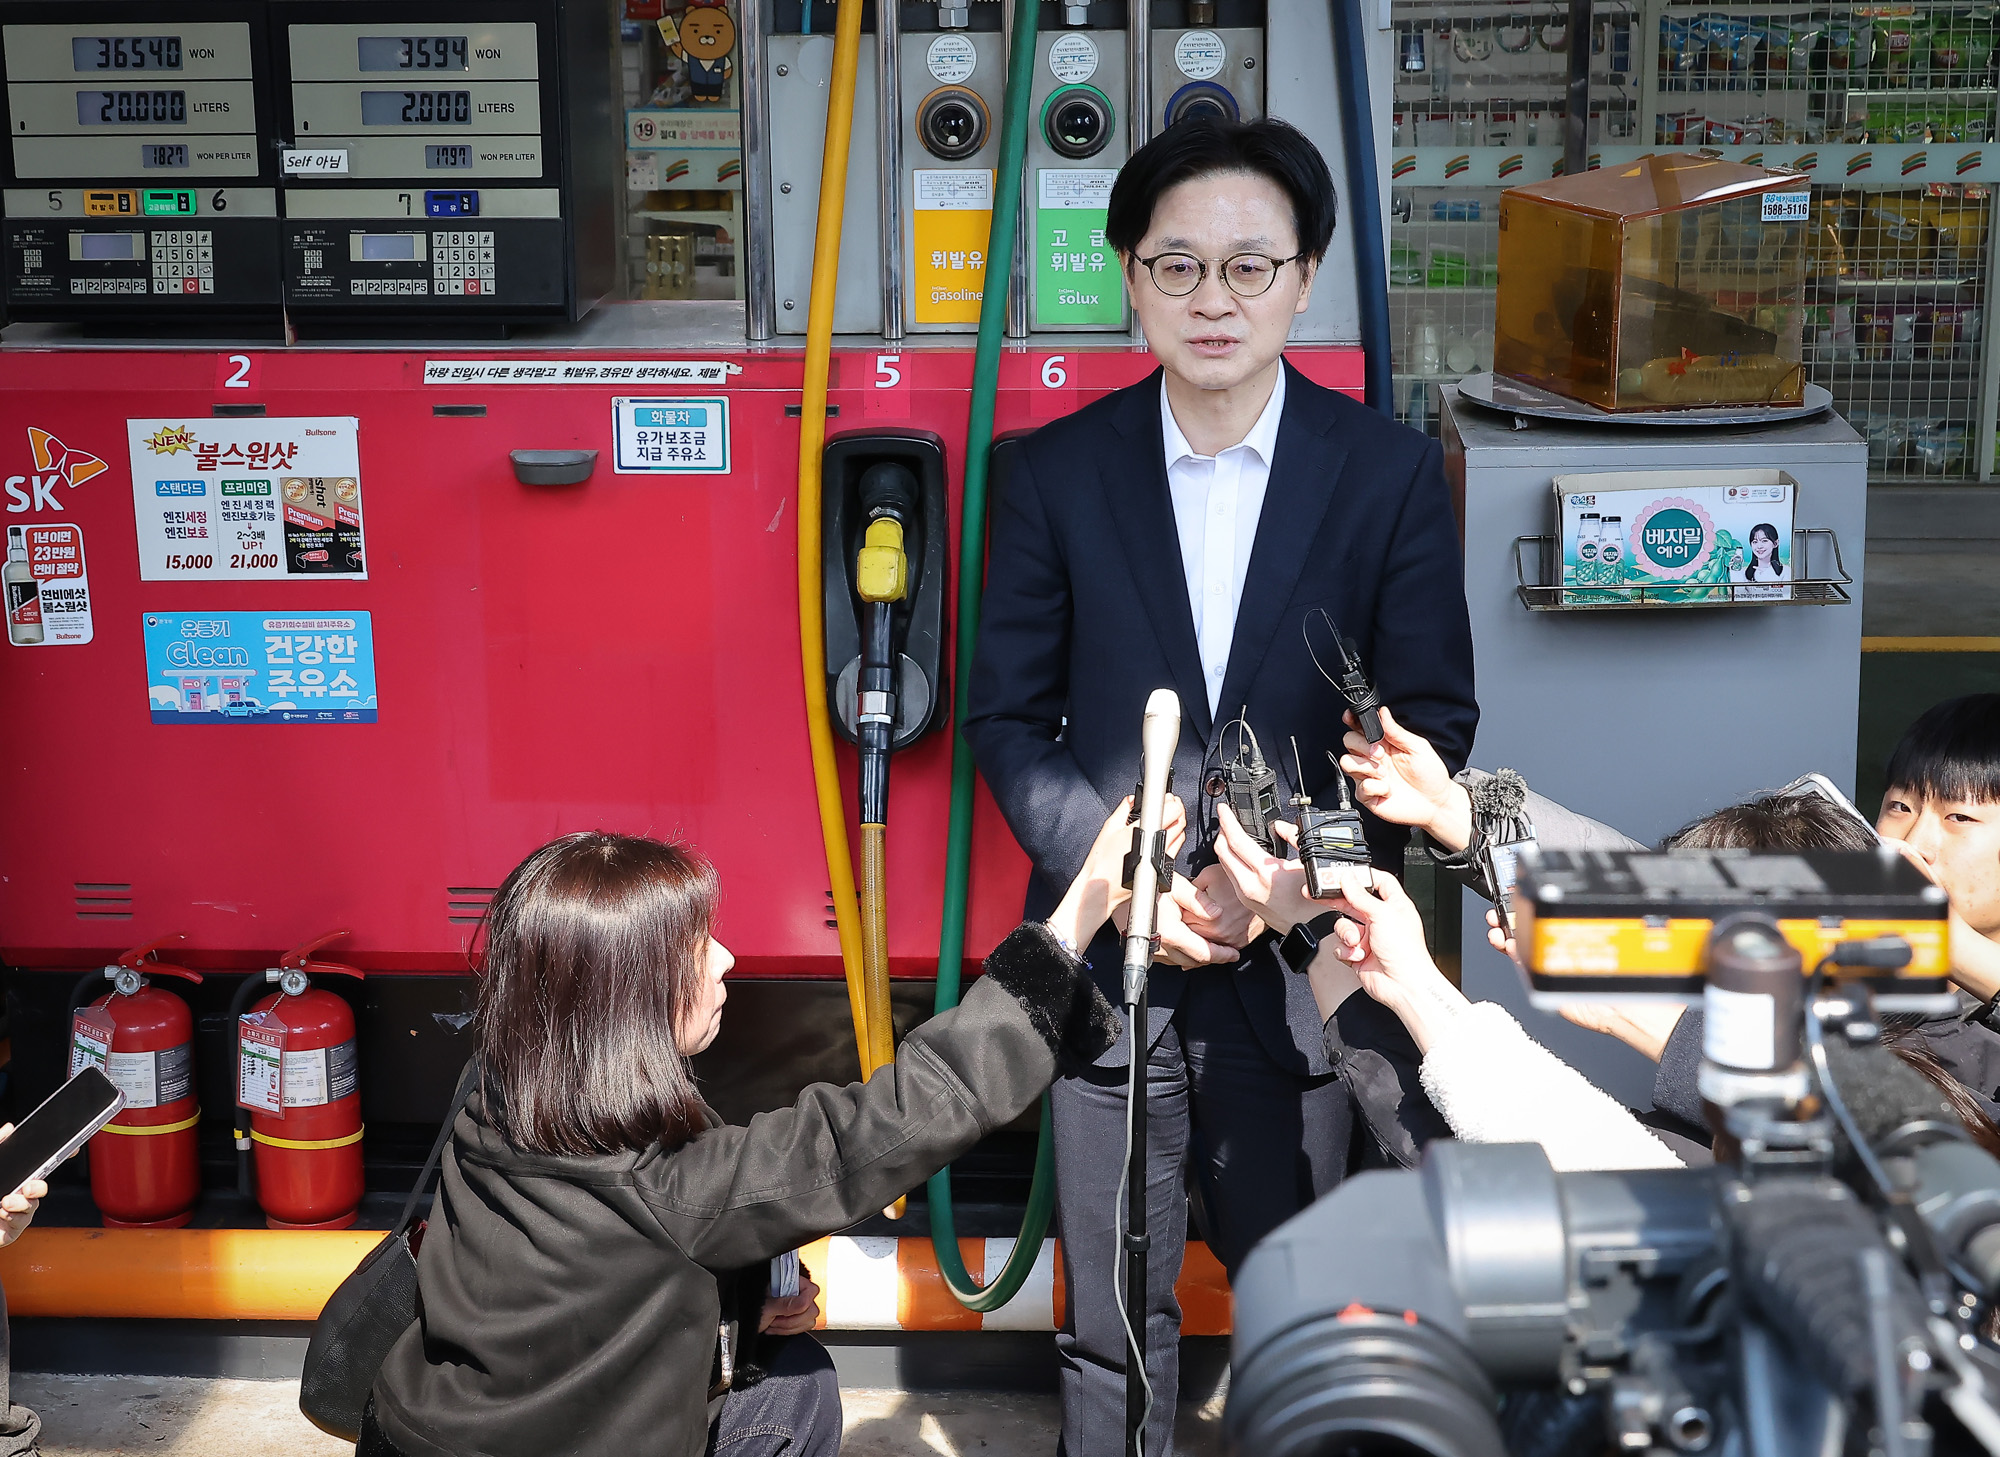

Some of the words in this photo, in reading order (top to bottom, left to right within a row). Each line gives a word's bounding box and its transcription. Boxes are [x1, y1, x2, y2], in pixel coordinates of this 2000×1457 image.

[97, 38, 181, 68] 36540
[189, 49, 215, 59] WON
[400, 38, 466, 68] 3594
[475, 49, 501, 59] WON
[101, 92, 185, 122] 20.000
[193, 102, 230, 113] LITERS
[402, 92, 469, 122] 2.000
[478, 103, 515, 113] LITERS
[637, 123, 653, 137] 19
[153, 147, 184, 165] 1827
[196, 152, 214, 160] WON
[215, 152, 229, 160] PER
[231, 152, 251, 160] LITER
[286, 155, 311, 168] Self
[315, 154, 342, 169] 아님
[436, 147, 466, 166] 1797
[480, 153, 498, 161] WON
[499, 153, 513, 161] PER
[515, 153, 535, 161] LITER
[48, 191, 63, 211] 5
[212, 189, 227, 211] 6
[398, 193, 412, 215] 7
[1763, 204, 1807, 215] 1588-5116
[155, 234, 163, 243] 7
[170, 234, 178, 243] 8
[186, 234, 193, 243] 9
[436, 234, 444, 244] 7
[452, 234, 459, 244] 8
[467, 234, 475, 244] 9
[155, 250, 163, 259] 4
[171, 250, 178, 259] 5
[186, 250, 194, 259] 6
[436, 251, 444, 260] 4
[452, 251, 459, 260] 5
[468, 251, 475, 260] 6
[930, 251, 985, 270] 휘발유
[1050, 252, 1107, 272] 휘발유
[157, 266, 162, 275] 1
[172, 266, 179, 275] 2
[187, 266, 194, 275] 3
[438, 267, 443, 276] 1
[453, 267, 460, 276] 2
[468, 267, 475, 276] 3
[72, 282, 83, 290] P1
[87, 282, 99, 290] P2
[102, 282, 115, 290] P3
[118, 282, 130, 290] P4
[133, 282, 146, 290] P5
[157, 281, 164, 291] 0
[186, 280, 195, 291] C
[203, 281, 210, 290] L
[352, 282, 364, 291] P1
[368, 282, 380, 291] P2
[383, 282, 396, 291] P3
[399, 282, 411, 291] P4
[414, 282, 426, 291] P5
[438, 282, 445, 292] 0
[467, 281, 477, 292] C
[484, 282, 491, 292] L
[931, 289, 984, 304] gasoline
[1058, 291, 1099, 304] solux
[224, 355, 252, 388] 2
[425, 367, 450, 378] 차량
[450, 367, 484, 379] 진입시
[486, 367, 511, 378] 다른
[513, 367, 557, 378] 생각말고
[636, 367, 693, 378] 생각하세요.
[697, 367, 721, 379] 제발
[875, 356, 901, 388] 5
[1040, 355, 1066, 388] 6
[651, 410, 690, 425] 화물차
[152, 432, 190, 449] NEW
[636, 431, 706, 445] 유가보조금
[193, 441, 299, 472] 불스원샷
[636, 446, 663, 461] 지급
[667, 446, 706, 461] 주유소
[5, 475, 64, 513] SK
[159, 482, 204, 494] 스탠다드
[224, 482, 269, 494] 프리미엄
[163, 511, 207, 524] 엔진세정
[221, 511, 276, 522] 엔진보호기능
[287, 506, 324, 527] Premium
[164, 527, 209, 539] 엔진보호
[236, 531, 266, 540] 2~3배
[1645, 527, 1702, 545] 베지밀
[1656, 546, 1689, 559] 에이
[33, 564, 56, 576] 연비
[56, 562, 79, 575] 절약
[165, 554, 213, 570] 15,000
[230, 554, 278, 570] 21,000
[41, 588, 87, 600] 연비에샷
[181, 619, 231, 638] 유증기
[268, 621, 315, 629] 유증기회수설비
[316, 621, 350, 629] 설치주유소
[166, 640, 249, 667] Clean
[265, 634, 358, 665] 건강한
[268, 668, 359, 698] 주유소
